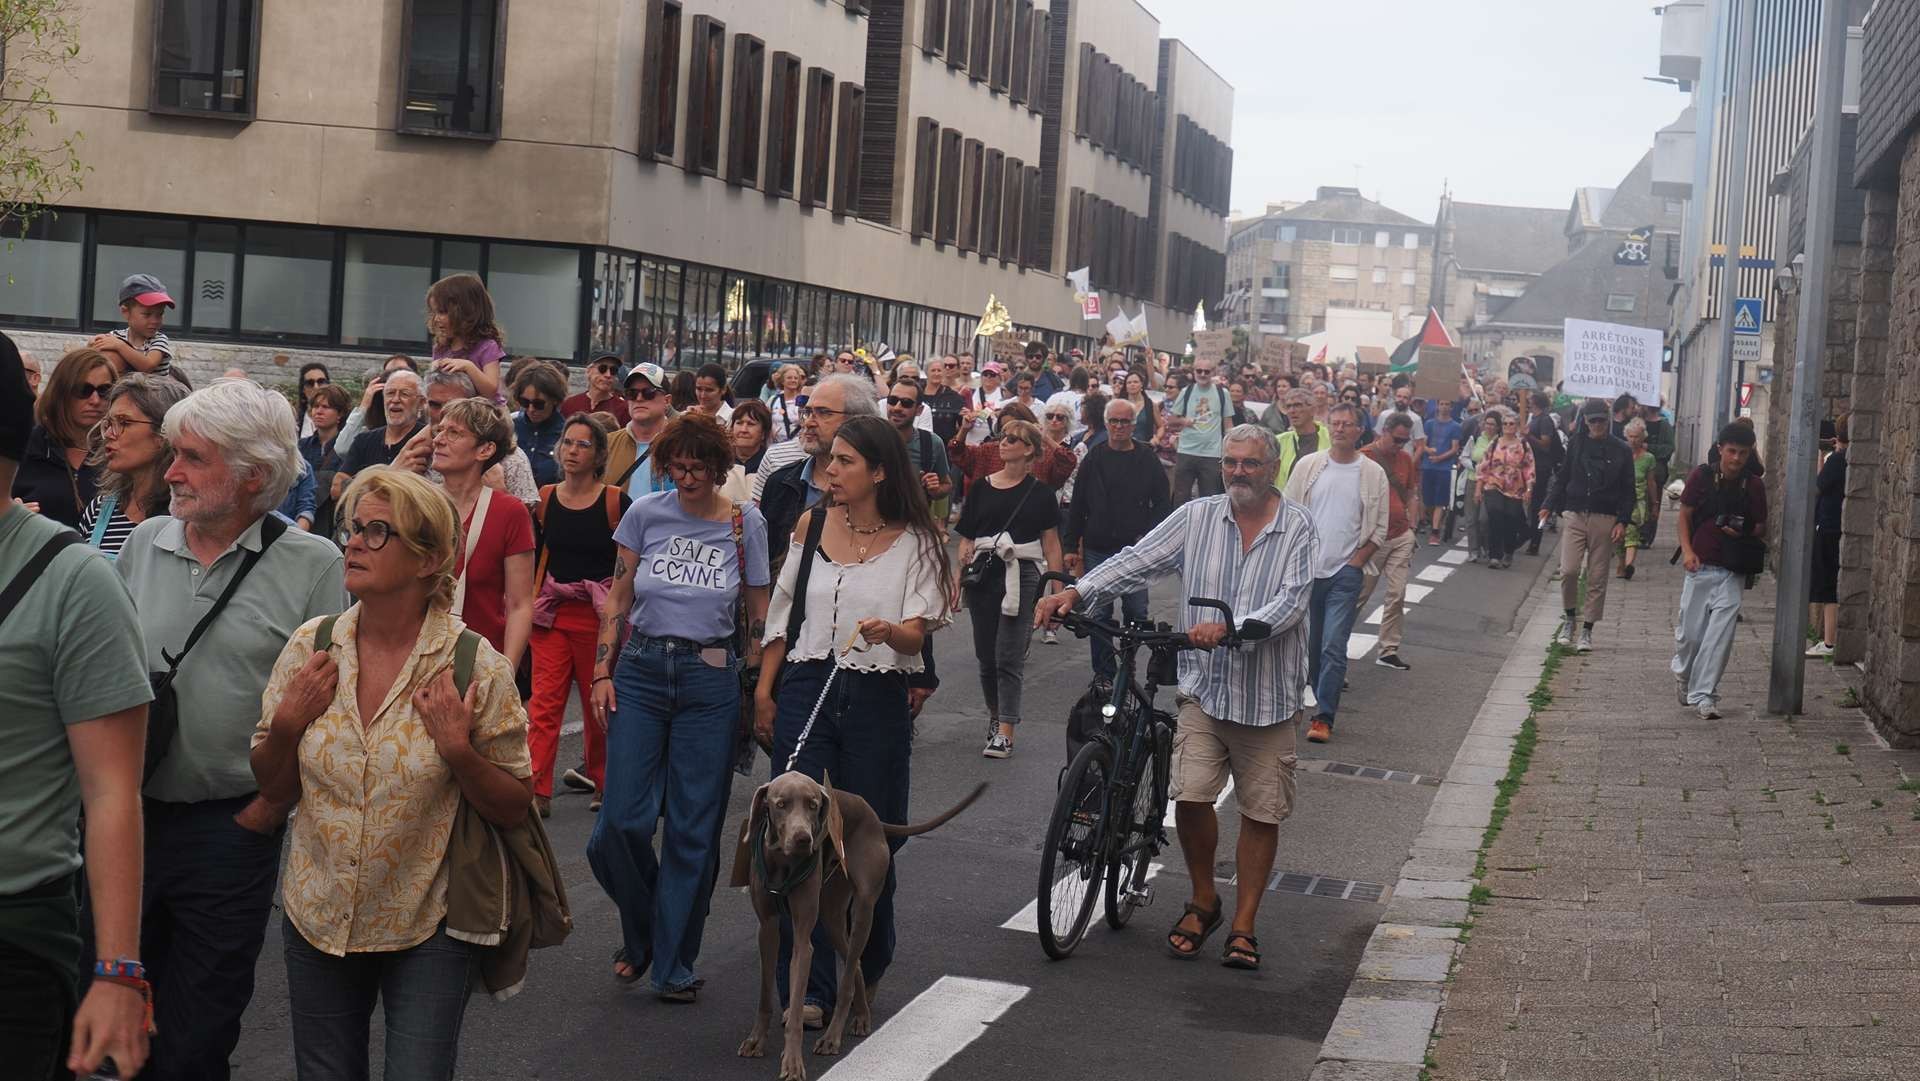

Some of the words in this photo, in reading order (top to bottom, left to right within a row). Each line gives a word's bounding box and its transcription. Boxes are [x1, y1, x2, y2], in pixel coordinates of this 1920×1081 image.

[1583, 330, 1644, 346] ARRÊTONS
[1582, 341, 1645, 357] D'ABBATRE
[1574, 352, 1596, 361] DES
[1601, 355, 1645, 369] ARBRES
[1573, 363, 1636, 378] ABBATONS
[1639, 373, 1651, 382] LE
[1571, 374, 1647, 392] CAPITALISME
[670, 537, 720, 568] SALE
